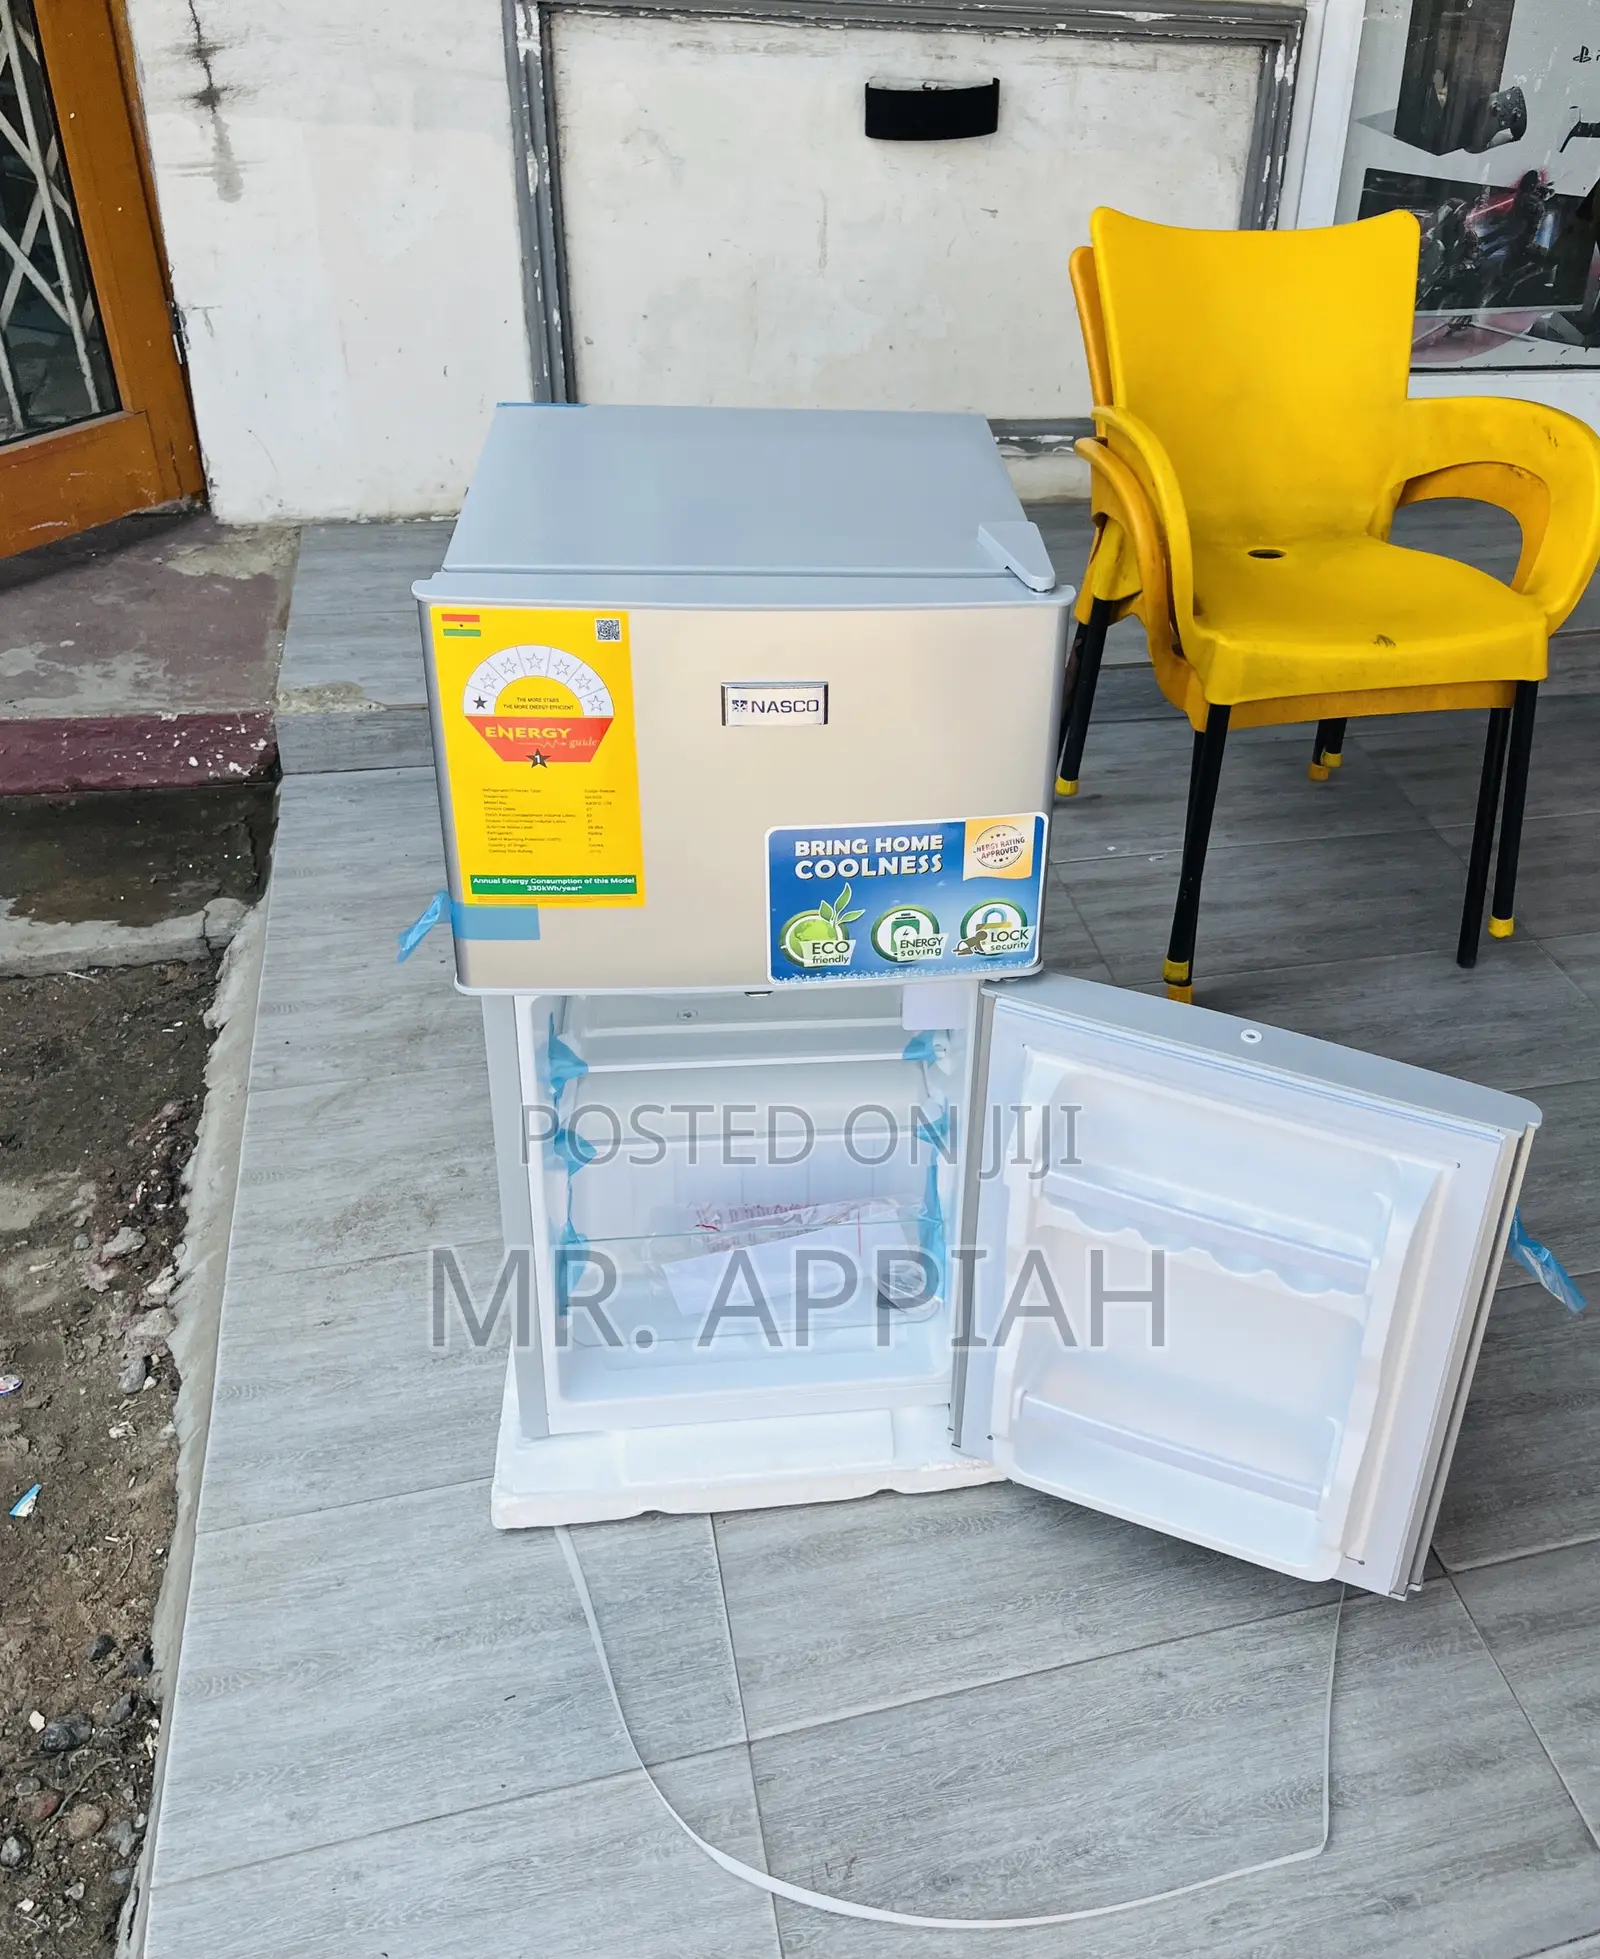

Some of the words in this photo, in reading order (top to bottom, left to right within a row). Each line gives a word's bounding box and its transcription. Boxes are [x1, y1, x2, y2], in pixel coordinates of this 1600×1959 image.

[751, 699, 819, 713] NASCO
[484, 724, 572, 741] ENERGY
[569, 736, 598, 749] guide
[534, 754, 541, 764] 1
[794, 838, 869, 857] BRING
[875, 833, 944, 854] HOME
[973, 842, 999, 853] NERGY
[1000, 836, 1026, 848] RATING
[981, 845, 1019, 860] APPROVED
[794, 853, 944, 880] COOLNESS
[502, 877, 529, 885] Energy
[530, 877, 583, 885] Consumption
[610, 876, 635, 884] Model
[900, 936, 944, 949] ENERGY
[990, 929, 1029, 943] LOCK
[811, 941, 850, 955] ECO
[900, 947, 943, 958] saving
[989, 940, 1030, 952] security
[811, 954, 850, 965] friendly
